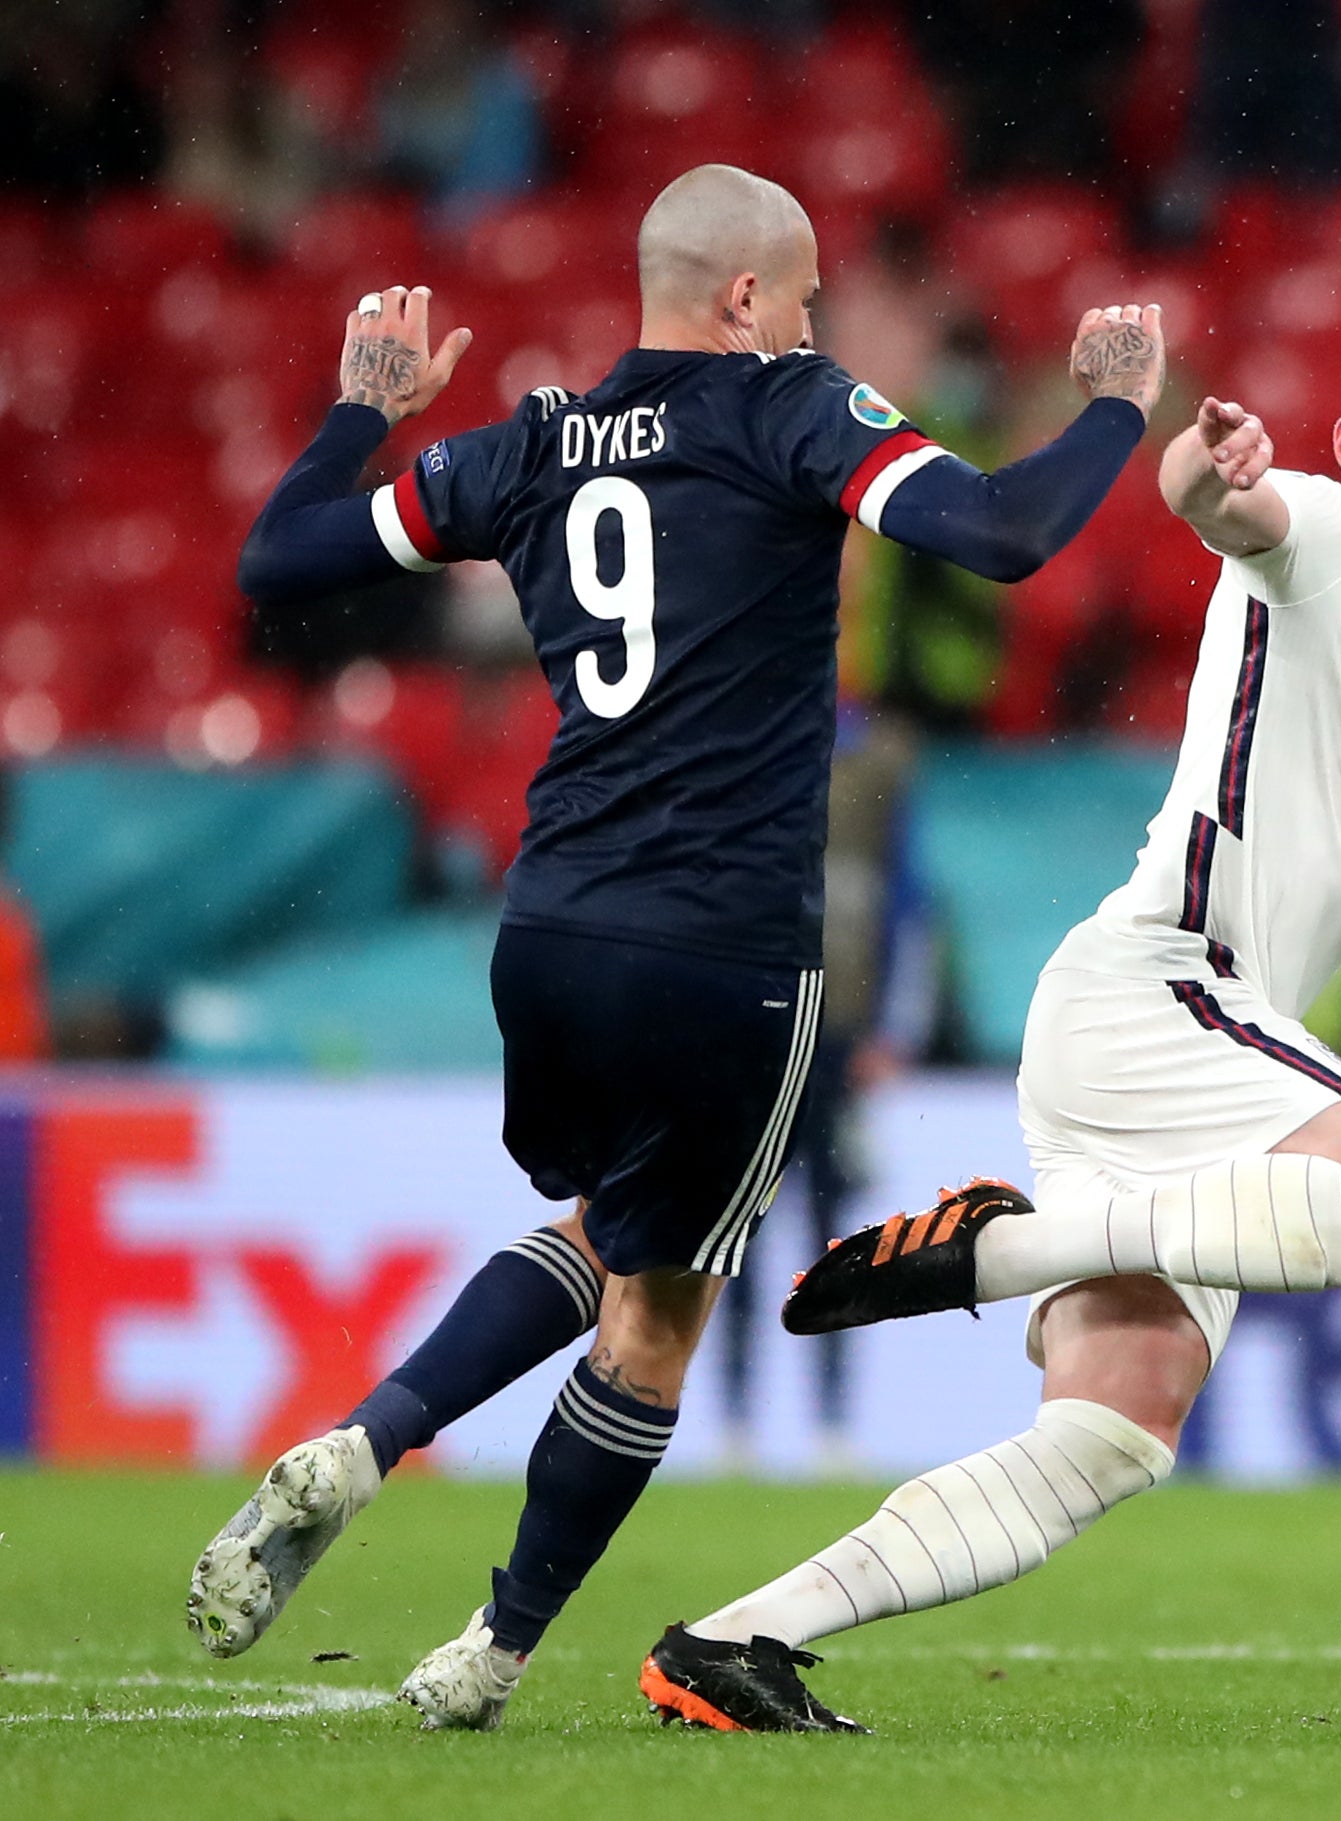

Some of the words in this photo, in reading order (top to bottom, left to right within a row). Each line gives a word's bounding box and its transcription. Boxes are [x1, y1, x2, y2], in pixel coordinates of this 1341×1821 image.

[562, 401, 667, 469] DYKES
[565, 476, 656, 719] 9
[0, 1108, 447, 1470] Ex
